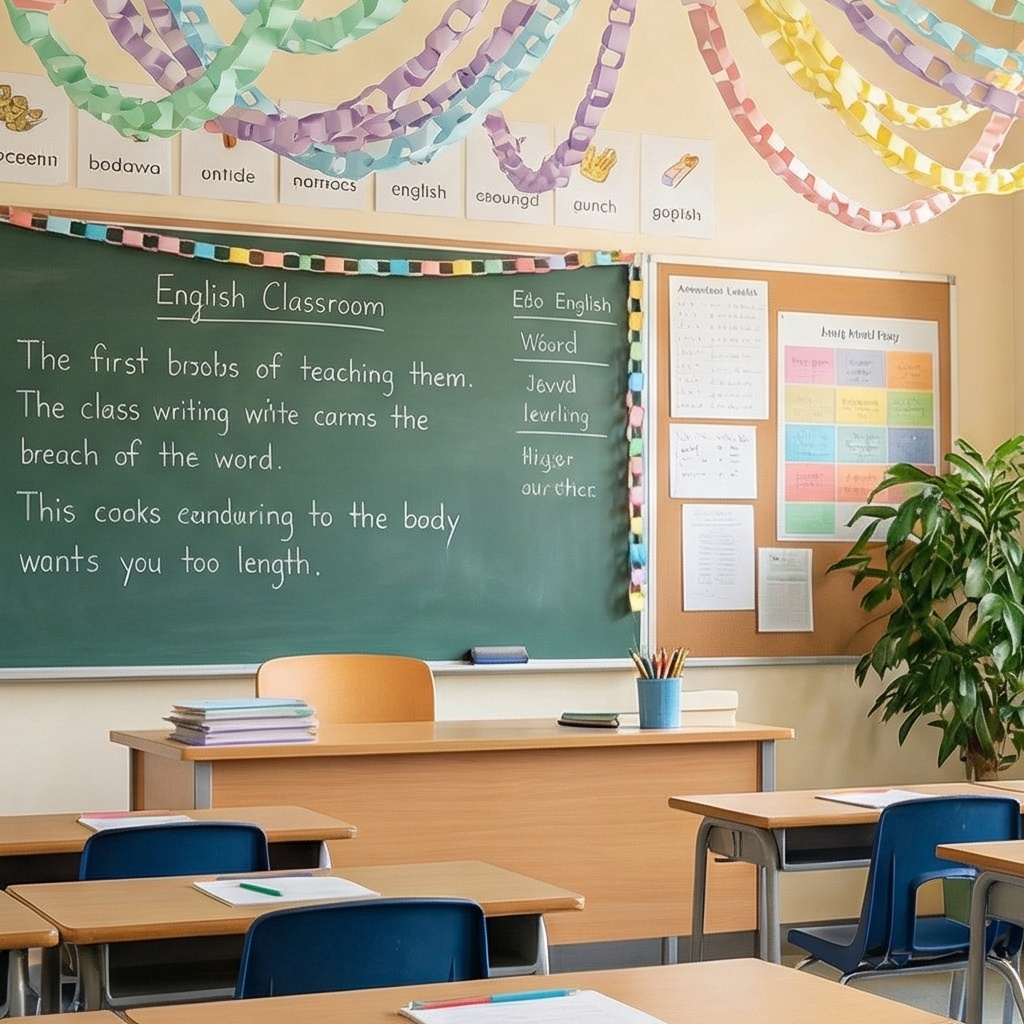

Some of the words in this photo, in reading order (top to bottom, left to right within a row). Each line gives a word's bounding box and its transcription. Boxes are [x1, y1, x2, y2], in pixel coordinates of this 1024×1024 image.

[89, 153, 161, 175] bodawa
[391, 182, 447, 202] english
[156, 273, 246, 324] English
[262, 281, 385, 317] Classroom
[555, 292, 612, 317] English
[16, 338, 71, 371] The
[89, 342, 149, 375] first
[256, 351, 283, 380] of
[299, 355, 394, 397] teaching
[409, 360, 473, 388] them.
[15, 389, 65, 419] The
[80, 391, 140, 421] class
[152, 398, 229, 437] writing
[314, 409, 377, 428] carms
[390, 404, 429, 431] the
[21, 436, 99, 466] breach
[114, 438, 143, 467] of
[158, 441, 200, 468] the
[214, 442, 282, 470] word.
[16, 490, 76, 524] This
[94, 498, 162, 524] cooks
[308, 499, 333, 527] to
[348, 501, 388, 530] the
[404, 500, 460, 549] body
[19, 544, 99, 573] wants
[119, 553, 162, 587] you
[180, 545, 220, 573] too
[238, 545, 321, 590] length.
